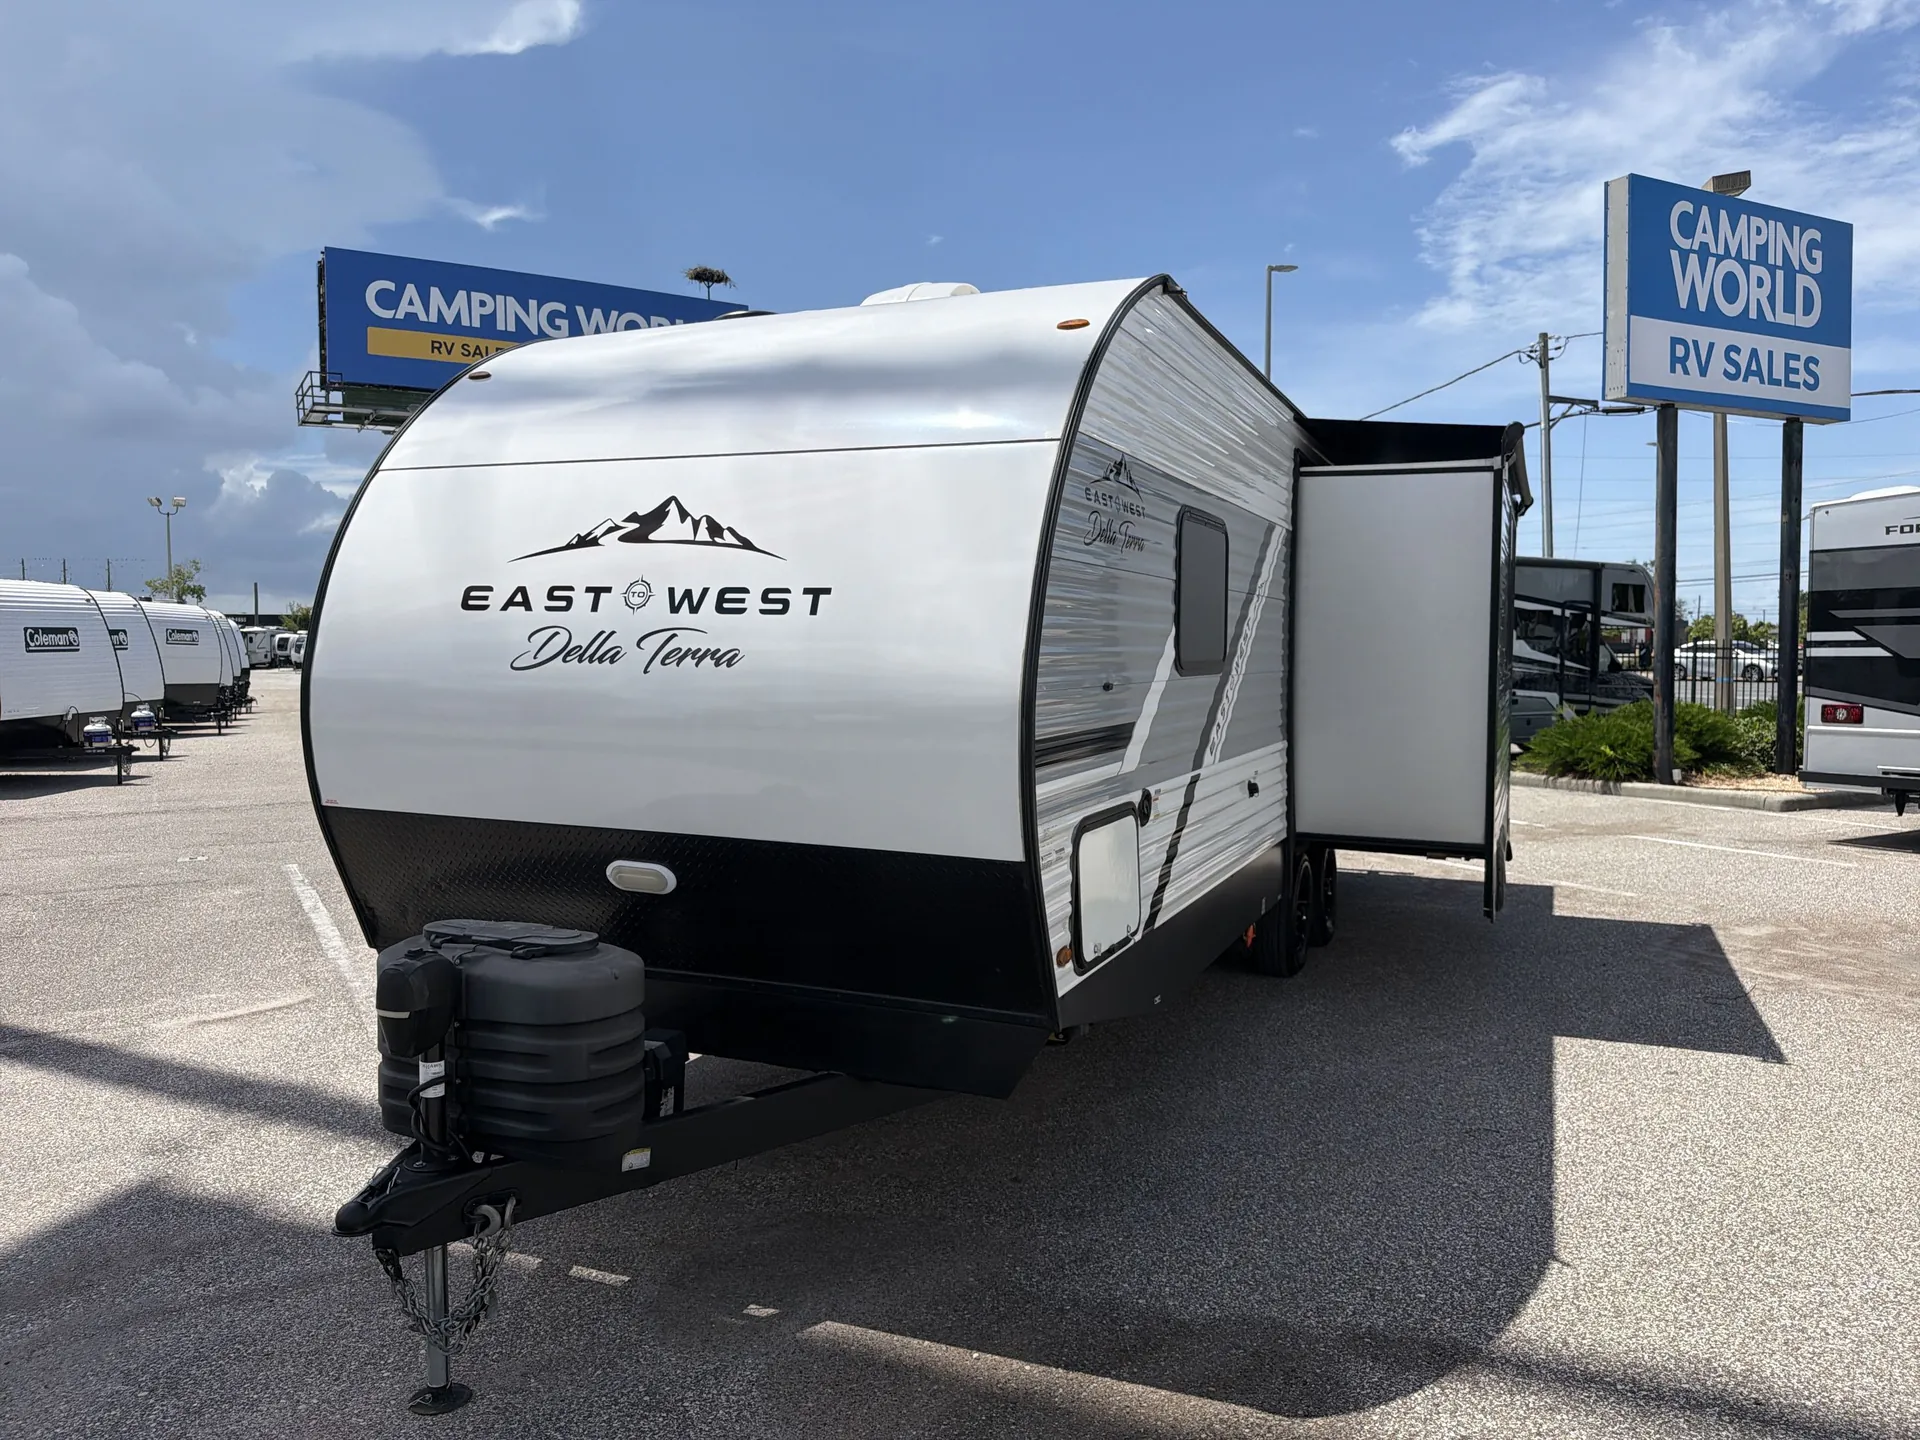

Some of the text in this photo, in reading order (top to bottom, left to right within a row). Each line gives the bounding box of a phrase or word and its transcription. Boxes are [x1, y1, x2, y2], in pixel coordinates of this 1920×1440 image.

[1669, 200, 1823, 275] CAMPING
[364, 279, 570, 339] CAMPING
[1669, 248, 1822, 329] WORLD
[430, 340, 455, 356] RV
[1669, 336, 1820, 392] RV SALES
[1084, 486, 1146, 519] EAST WEST
[1083, 510, 1147, 554] Della Terra
[460, 584, 614, 613] EAST
[667, 586, 833, 616] WEST
[26, 628, 69, 647] Coleman
[167, 629, 193, 641] Coleman
[509, 625, 746, 675] Della Terra
